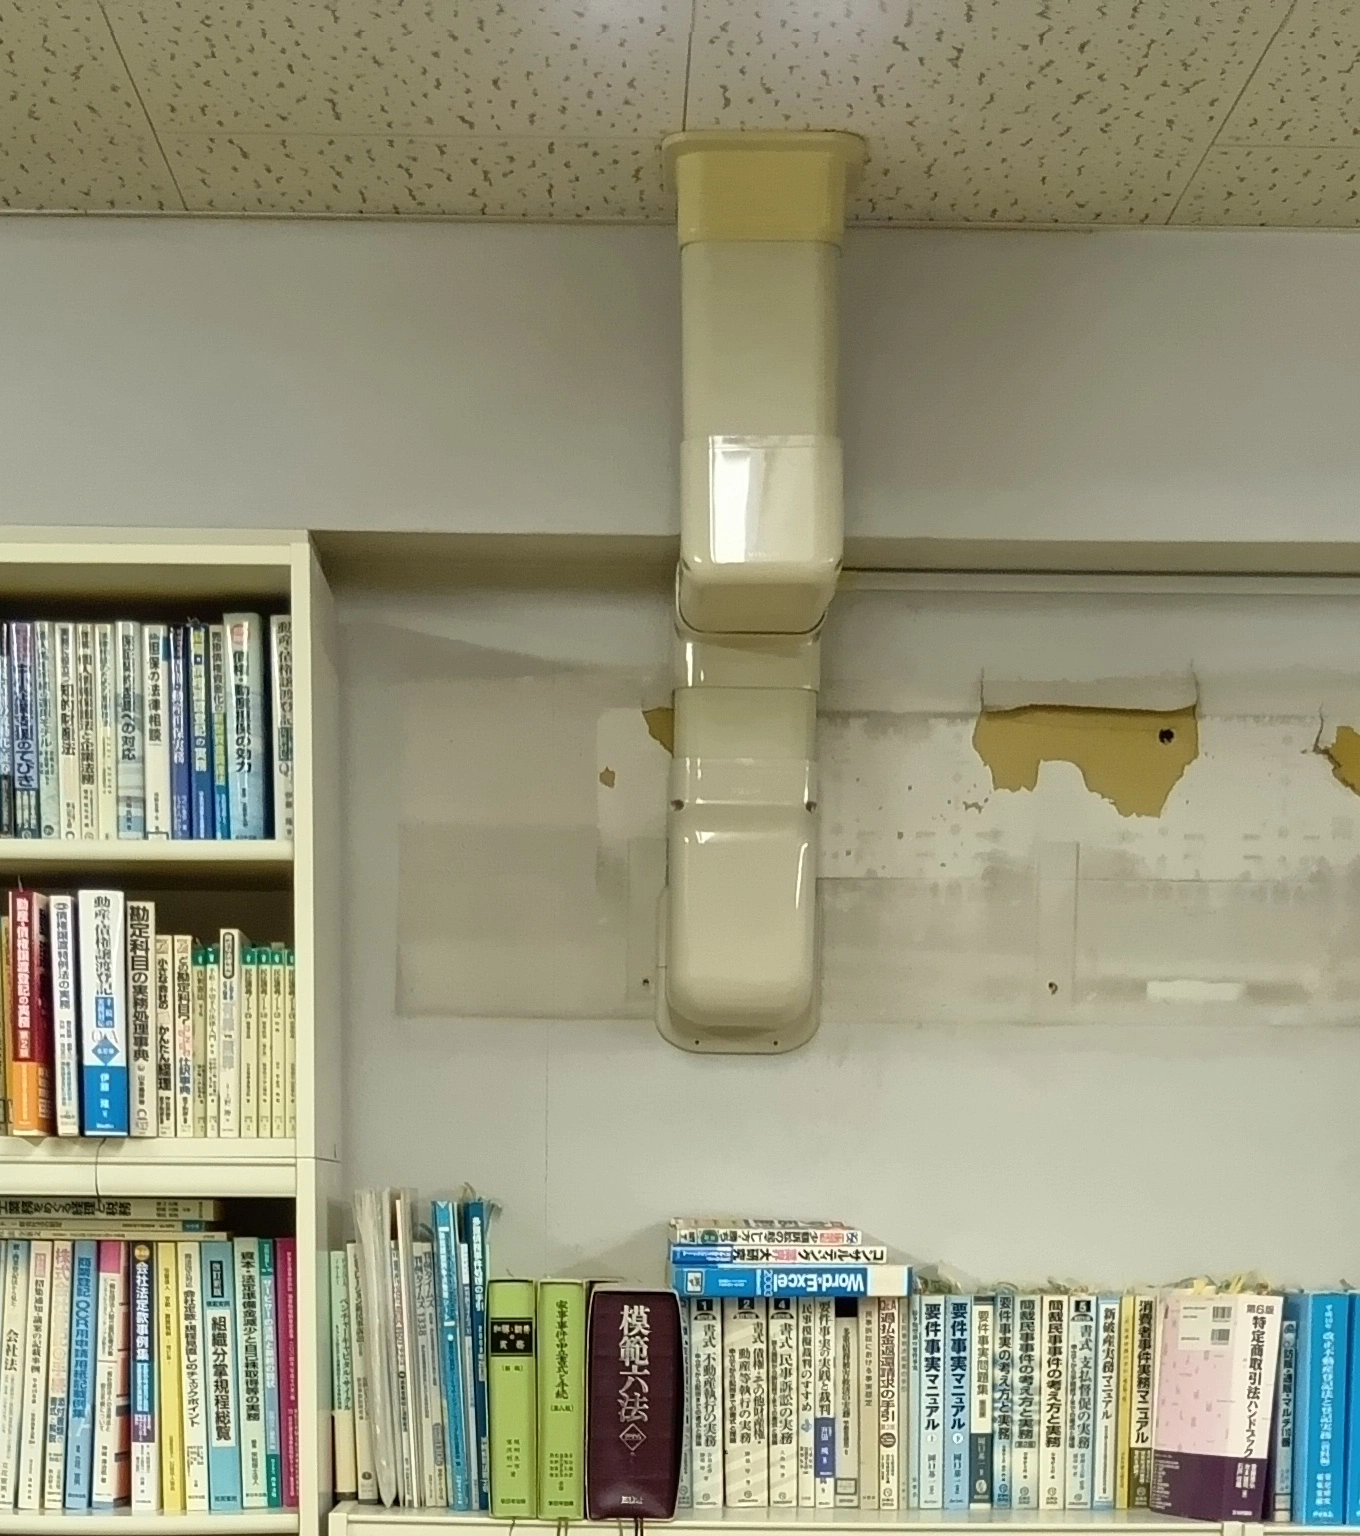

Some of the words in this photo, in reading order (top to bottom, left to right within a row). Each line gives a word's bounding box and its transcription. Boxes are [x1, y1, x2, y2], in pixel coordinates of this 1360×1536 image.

[4, 1328, 20, 1372] 会社法
[135, 1261, 151, 1361] 会社法定款事例集
[240, 1251, 261, 1422] 資本・法定準備金減少と自己株取得等の実務
[617, 1304, 652, 1424] 模範六法
[702, 1323, 716, 1349] 書式
[751, 1321, 765, 1345] 書式
[779, 1323, 794, 1350] 書式
[976, 1310, 989, 1396] 要件事実問題集
[1101, 1307, 1115, 1420] 新破産実務マニュアル
[1246, 1304, 1275, 1315] 第6版
[211, 1316, 232, 1442] 組織分掌規程総覧
[703, 1353, 717, 1447] 不動産執行の実務
[738, 1348, 752, 1445] 動産等執行の実務
[779, 1353, 794, 1446] 民事訴訟の実務
[880, 1311, 897, 1423] 過払金返還請求の手引
[924, 1303, 942, 1431] 要件事実マニュアル
[950, 1303, 967, 1431] 要件事実マニュアル
[997, 1297, 1012, 1441] 要件事実の考え方と実務
[1017, 1299, 1035, 1440] 簡裁民事事件の考え方と実務
[1045, 1299, 1064, 1448] 簡裁民事事件の考え方と実務
[1077, 1356, 1091, 1449] 支払督促の実務
[1134, 1300, 1153, 1444] 消費者事件実務マニュアル
[1243, 1316, 1267, 1459] 特定商取引法ハンドブック
